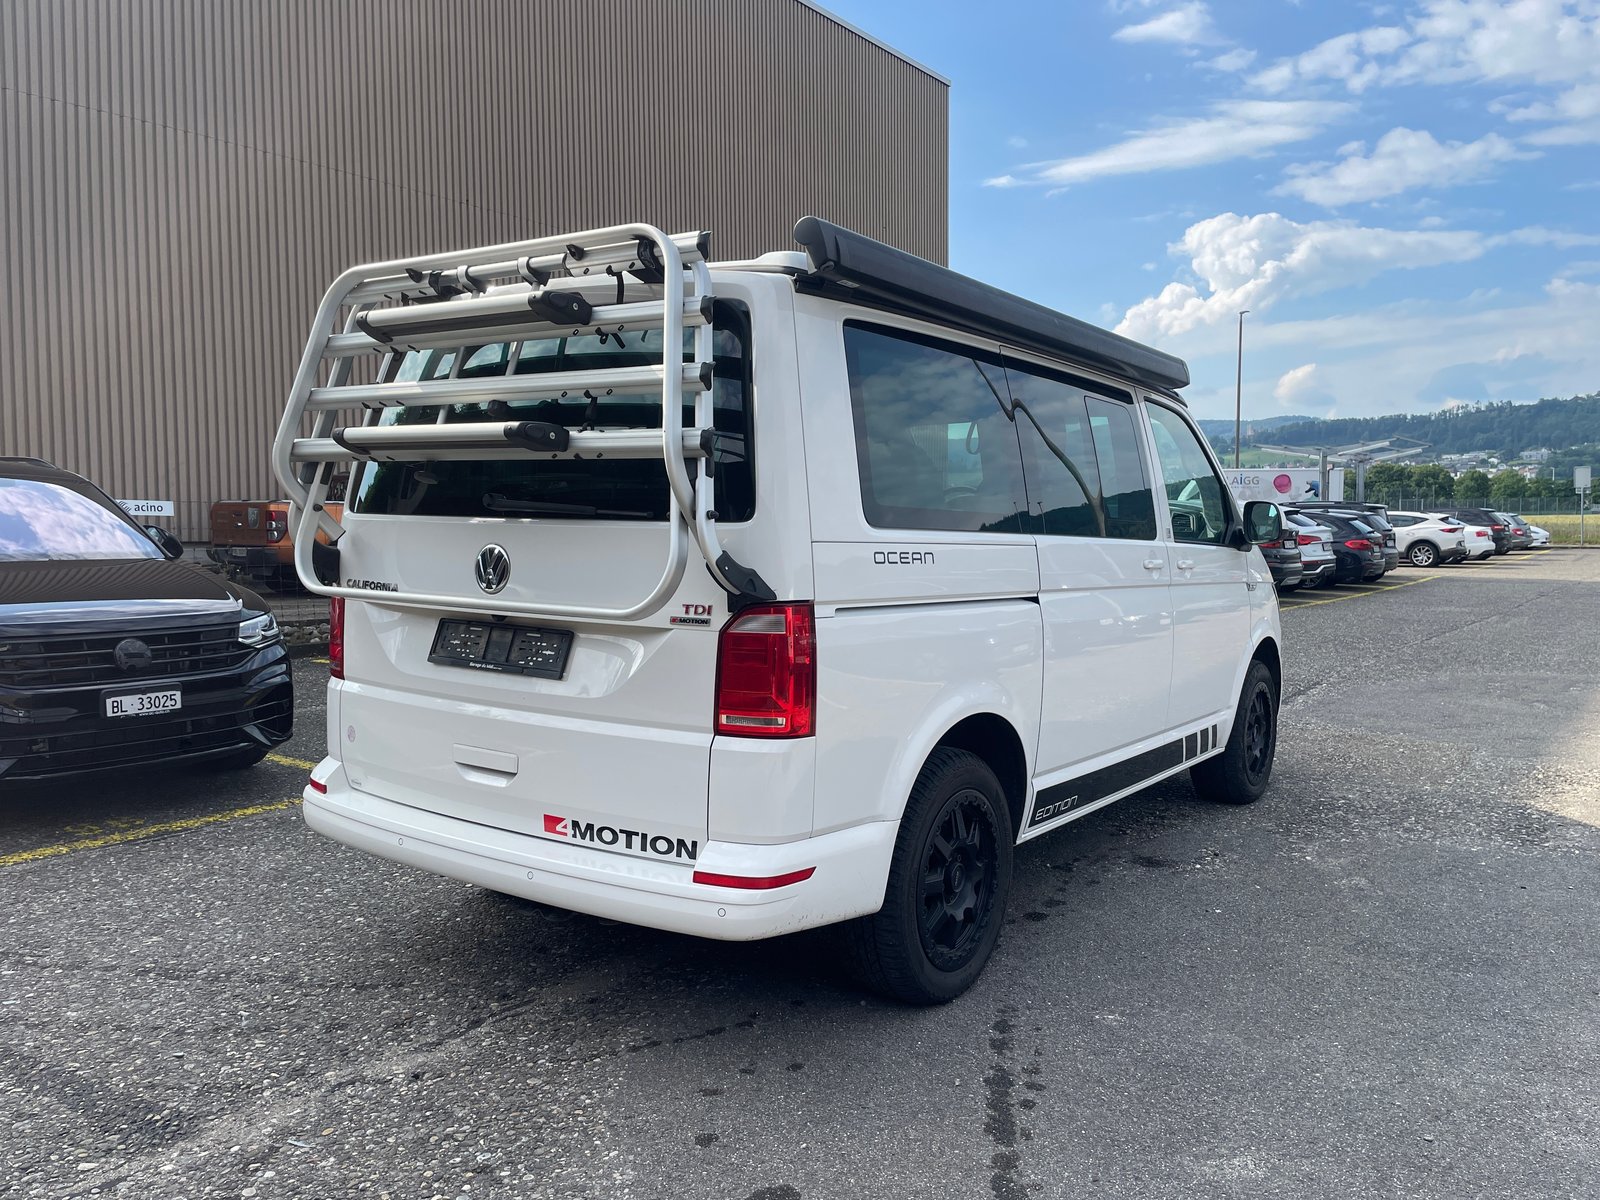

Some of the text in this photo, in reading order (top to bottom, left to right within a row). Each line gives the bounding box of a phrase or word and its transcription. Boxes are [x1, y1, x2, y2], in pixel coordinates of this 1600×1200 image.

[134, 502, 164, 512] acino
[873, 551, 935, 565] OCEAN
[346, 578, 399, 592] CALIFORNIA
[682, 603, 713, 616] TDI
[111, 693, 178, 715] BL 33025
[1035, 795, 1078, 821] EDITION
[544, 814, 699, 860] 4MOTION
